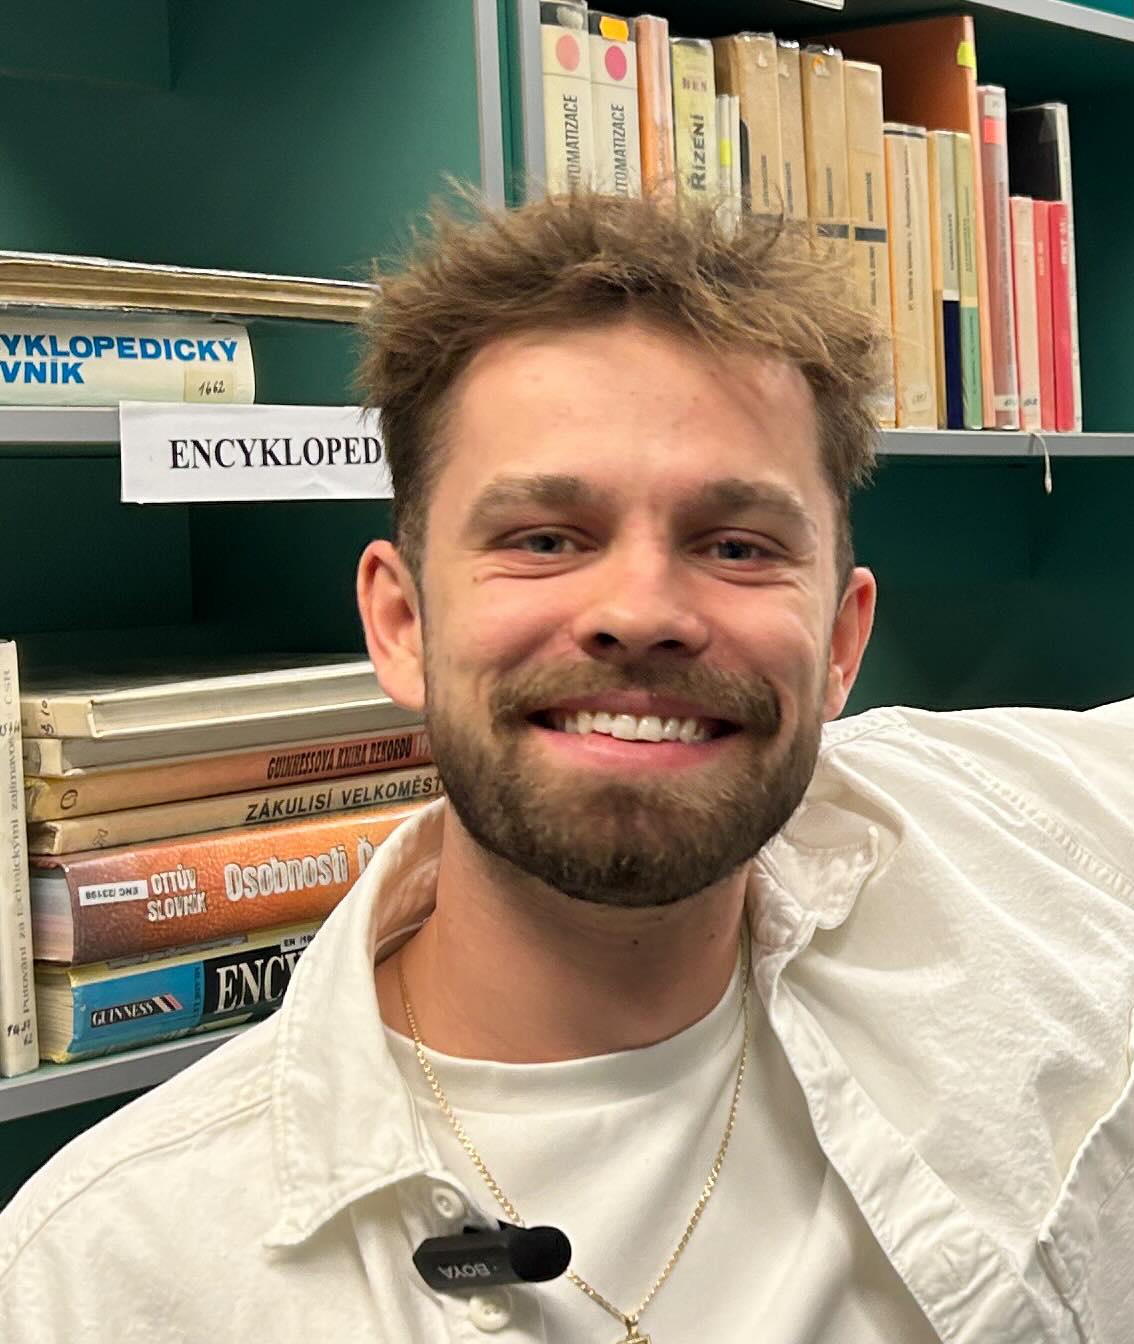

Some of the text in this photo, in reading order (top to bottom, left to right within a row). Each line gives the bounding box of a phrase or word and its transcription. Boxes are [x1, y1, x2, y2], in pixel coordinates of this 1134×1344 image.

[561, 94, 580, 191] TOMATIZACE
[198, 379, 226, 397] 1662
[169, 436, 383, 470] ENCYKLOPED
[245, 788, 334, 823] ZÁKULISÍ
[151, 862, 197, 894] OTTŮV
[224, 844, 349, 902] Osobnosti
[146, 889, 208, 922] SLOVNÍK
[91, 996, 155, 1029] GUINNESS
[437, 1263, 491, 1280] BOYA
